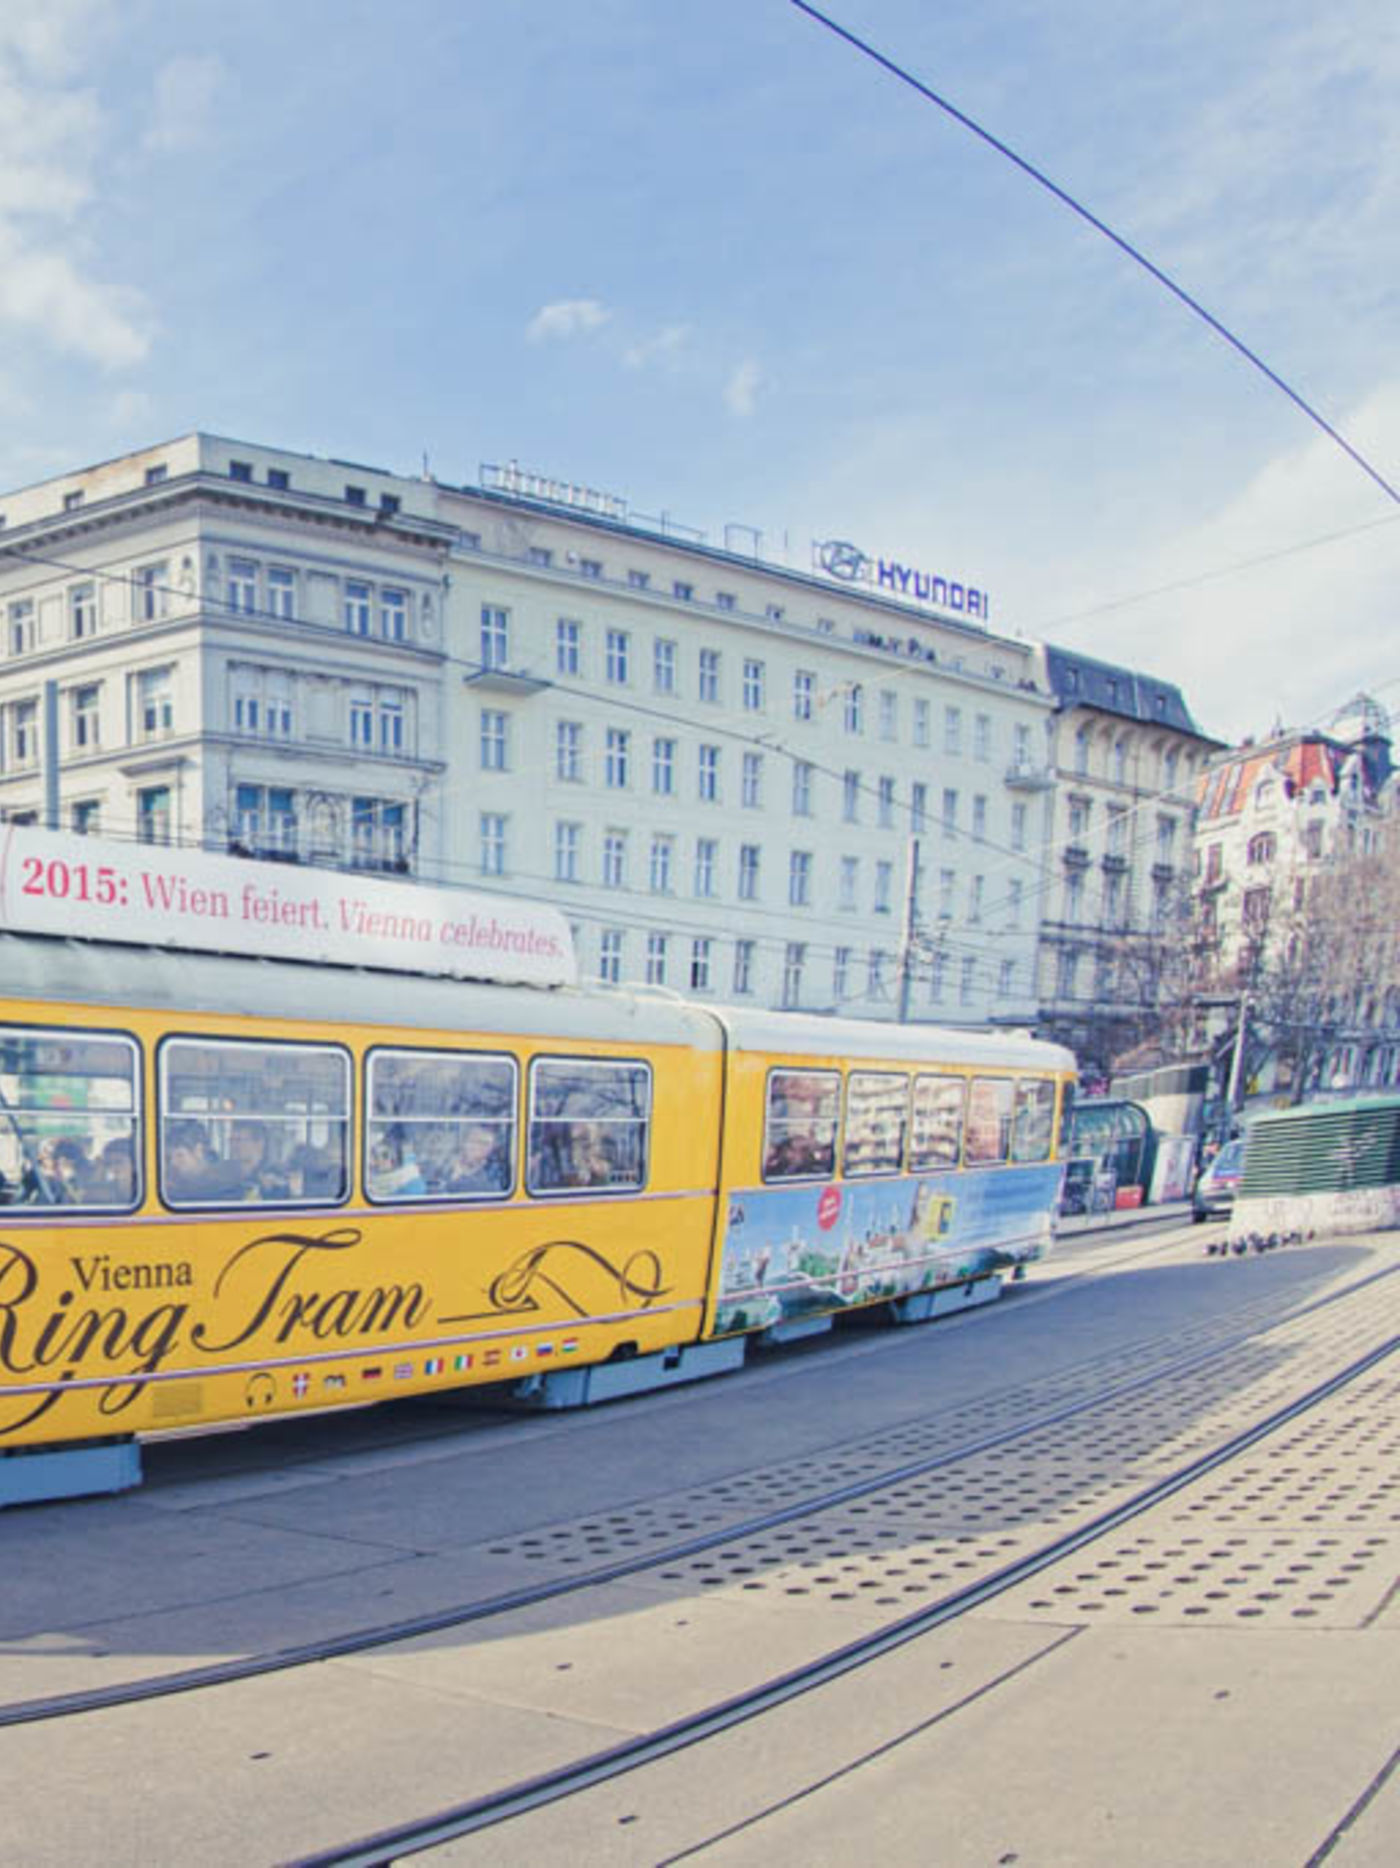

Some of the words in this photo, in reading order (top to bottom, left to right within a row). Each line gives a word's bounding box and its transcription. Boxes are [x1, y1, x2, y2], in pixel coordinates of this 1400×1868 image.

[877, 559, 988, 619] HYUNDAI
[22, 857, 129, 905] 2015:
[141, 871, 229, 918] Wien
[241, 883, 329, 930] feiert.
[338, 898, 432, 943] Vienna
[439, 919, 564, 957] celebrates.
[70, 1255, 193, 1292] Vienna
[190, 1228, 432, 1352] Tram
